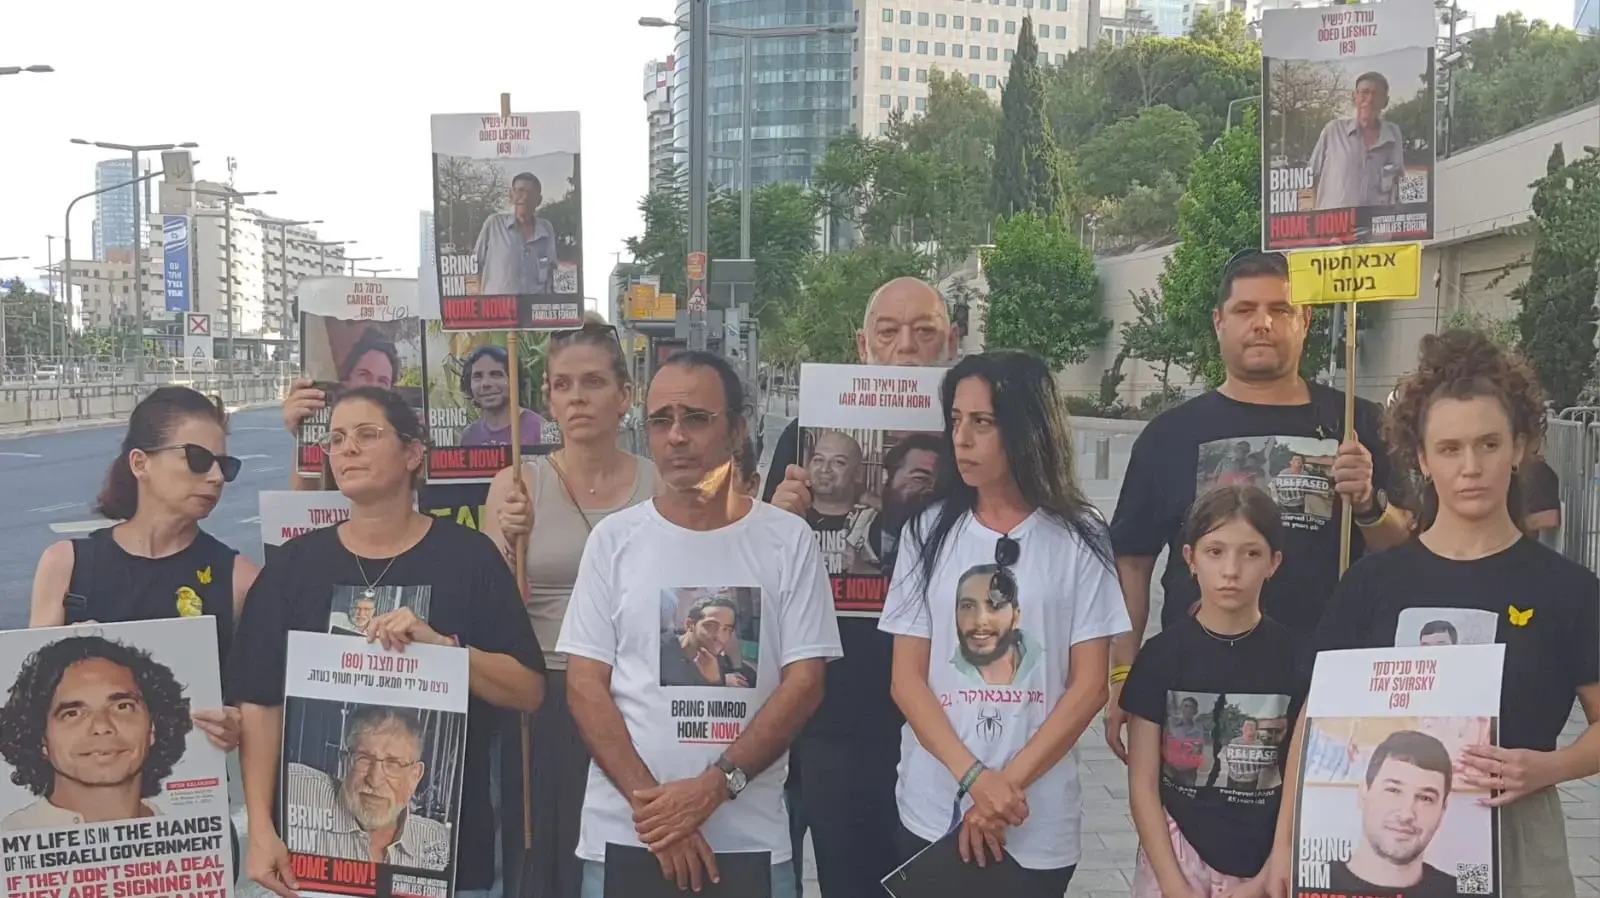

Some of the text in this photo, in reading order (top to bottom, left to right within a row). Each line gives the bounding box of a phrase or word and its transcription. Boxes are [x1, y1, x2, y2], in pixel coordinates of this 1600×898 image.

[1322, 10, 1374, 28] עודד ליפשיץ
[1318, 24, 1378, 42] ODED LIFSHITZ
[1339, 39, 1356, 55] (83)
[510, 116, 528, 127] עודד
[479, 129, 530, 141] ODED LIFSHITZ
[1270, 167, 1314, 190] BRING
[1270, 190, 1298, 214] HIM
[1270, 208, 1356, 238] HOME NOW!
[1372, 220, 1427, 234] FAMILIES FORUM
[440, 254, 478, 275] BRING
[1311, 253, 1396, 276] אבא חטוף
[442, 275, 466, 296] HIM
[1333, 276, 1376, 293] בעזה
[346, 294, 389, 306] CARMEL GAT
[444, 297, 517, 320] HOME NOW!
[360, 307, 375, 317] (39)
[381, 305, 409, 320] (40)
[532, 310, 578, 320] FAMILIES FORUM
[853, 378, 918, 393] איתן ויאיר הורן
[839, 392, 931, 409] IAIR AND EITAN HORN
[428, 407, 467, 426] BRING
[429, 428, 454, 447] HIM
[431, 449, 506, 469] HOME NOW!
[1276, 478, 1329, 490] RELEASED
[282, 528, 312, 538] MAT
[812, 530, 846, 551] RING
[341, 652, 418, 674] יורם מצבר (80)
[1373, 660, 1437, 677] איתי סבירסקי
[307, 669, 449, 694] נרצח על ידי חמאס. עדיין חטוף בעזה.
[1369, 676, 1435, 692] ITAY SVIRSKY
[1027, 691, 1044, 704] מתן
[1389, 693, 1410, 710] (38)
[671, 700, 747, 719] BRING NIMROD
[677, 721, 740, 740] HOME NOW!
[1226, 748, 1278, 760] RELEASE
[288, 804, 334, 831] BRING
[3, 816, 222, 853] MY LIFE IS IN THE HANDS
[288, 828, 317, 852] HIM
[4, 835, 223, 872] OF THE ISRAELI GOVERNMENT
[1300, 837, 1352, 862] BRING
[7, 855, 224, 891] IF THEY DON'T SIGN A DEAL
[333, 859, 376, 886] NOW!
[1298, 863, 1332, 889] HIM
[68, 884, 108, 898] ARE
[113, 875, 191, 898] SIGNING
[195, 870, 224, 889] MY
[392, 881, 447, 898] FAMILIES FORUM
